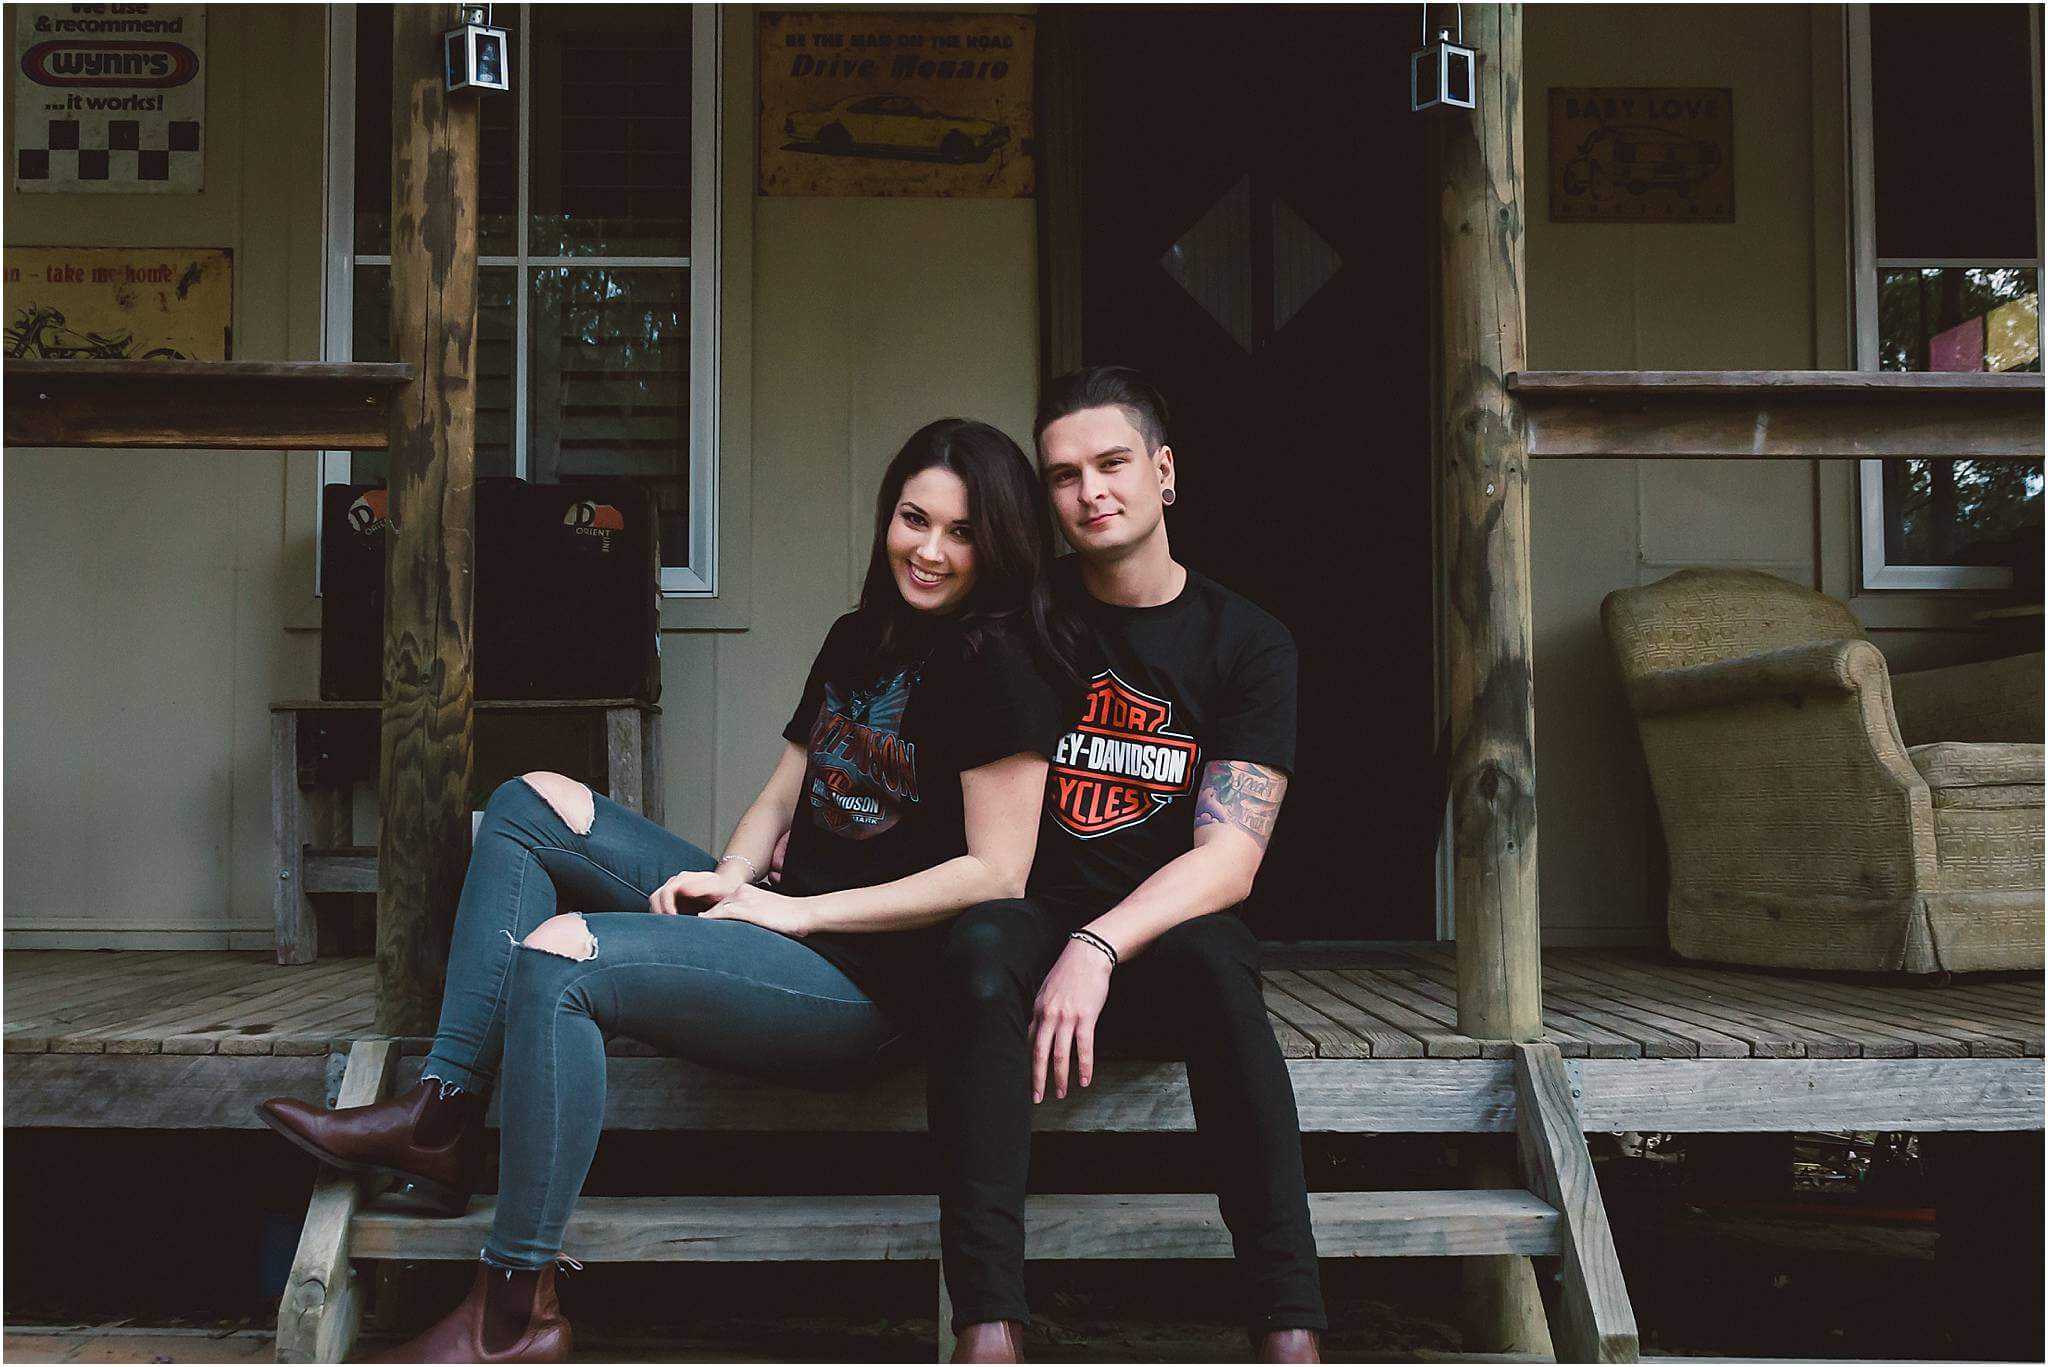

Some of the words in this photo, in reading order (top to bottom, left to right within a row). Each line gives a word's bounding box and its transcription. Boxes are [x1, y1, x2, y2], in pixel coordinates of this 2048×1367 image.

[111, 3, 148, 15] use
[35, 15, 51, 32] &
[55, 16, 183, 33] recommend
[812, 34, 843, 47] THE
[931, 35, 961, 48] THE
[790, 53, 876, 77] Drive
[86, 95, 164, 110] works!
[1566, 98, 1635, 119] BABY
[1649, 98, 1718, 120] LOVE
[47, 264, 84, 283] take
[576, 527, 610, 536] ORIENT
[1058, 776, 1140, 824] YCLES
